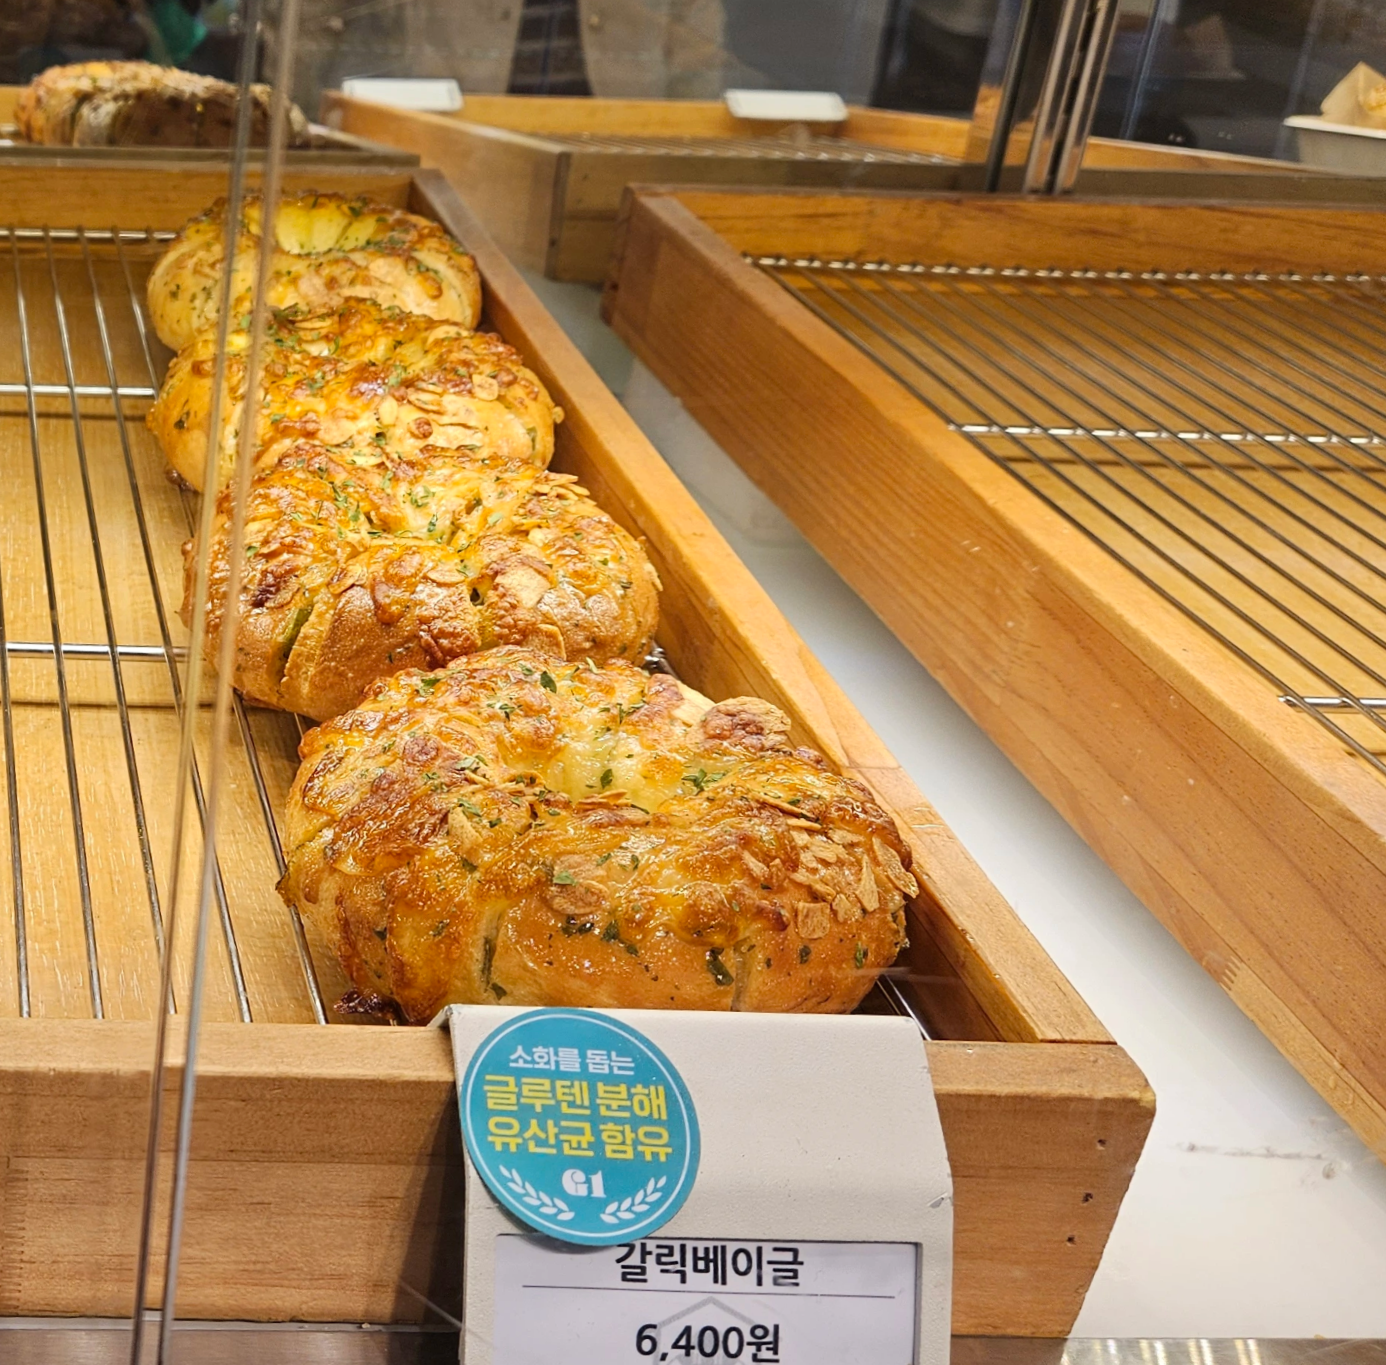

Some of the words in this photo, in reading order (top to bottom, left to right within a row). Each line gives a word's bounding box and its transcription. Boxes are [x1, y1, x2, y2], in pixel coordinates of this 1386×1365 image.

[509, 1046, 581, 1072] 소화를
[586, 1050, 635, 1076] 돕는
[483, 1075, 590, 1115] 글루텐
[596, 1083, 667, 1120] 분해
[487, 1117, 595, 1157] 유산균
[601, 1123, 673, 1162] 함유
[615, 1243, 804, 1286] 갈릭베이글
[636, 1323, 780, 1363] 6,400원
